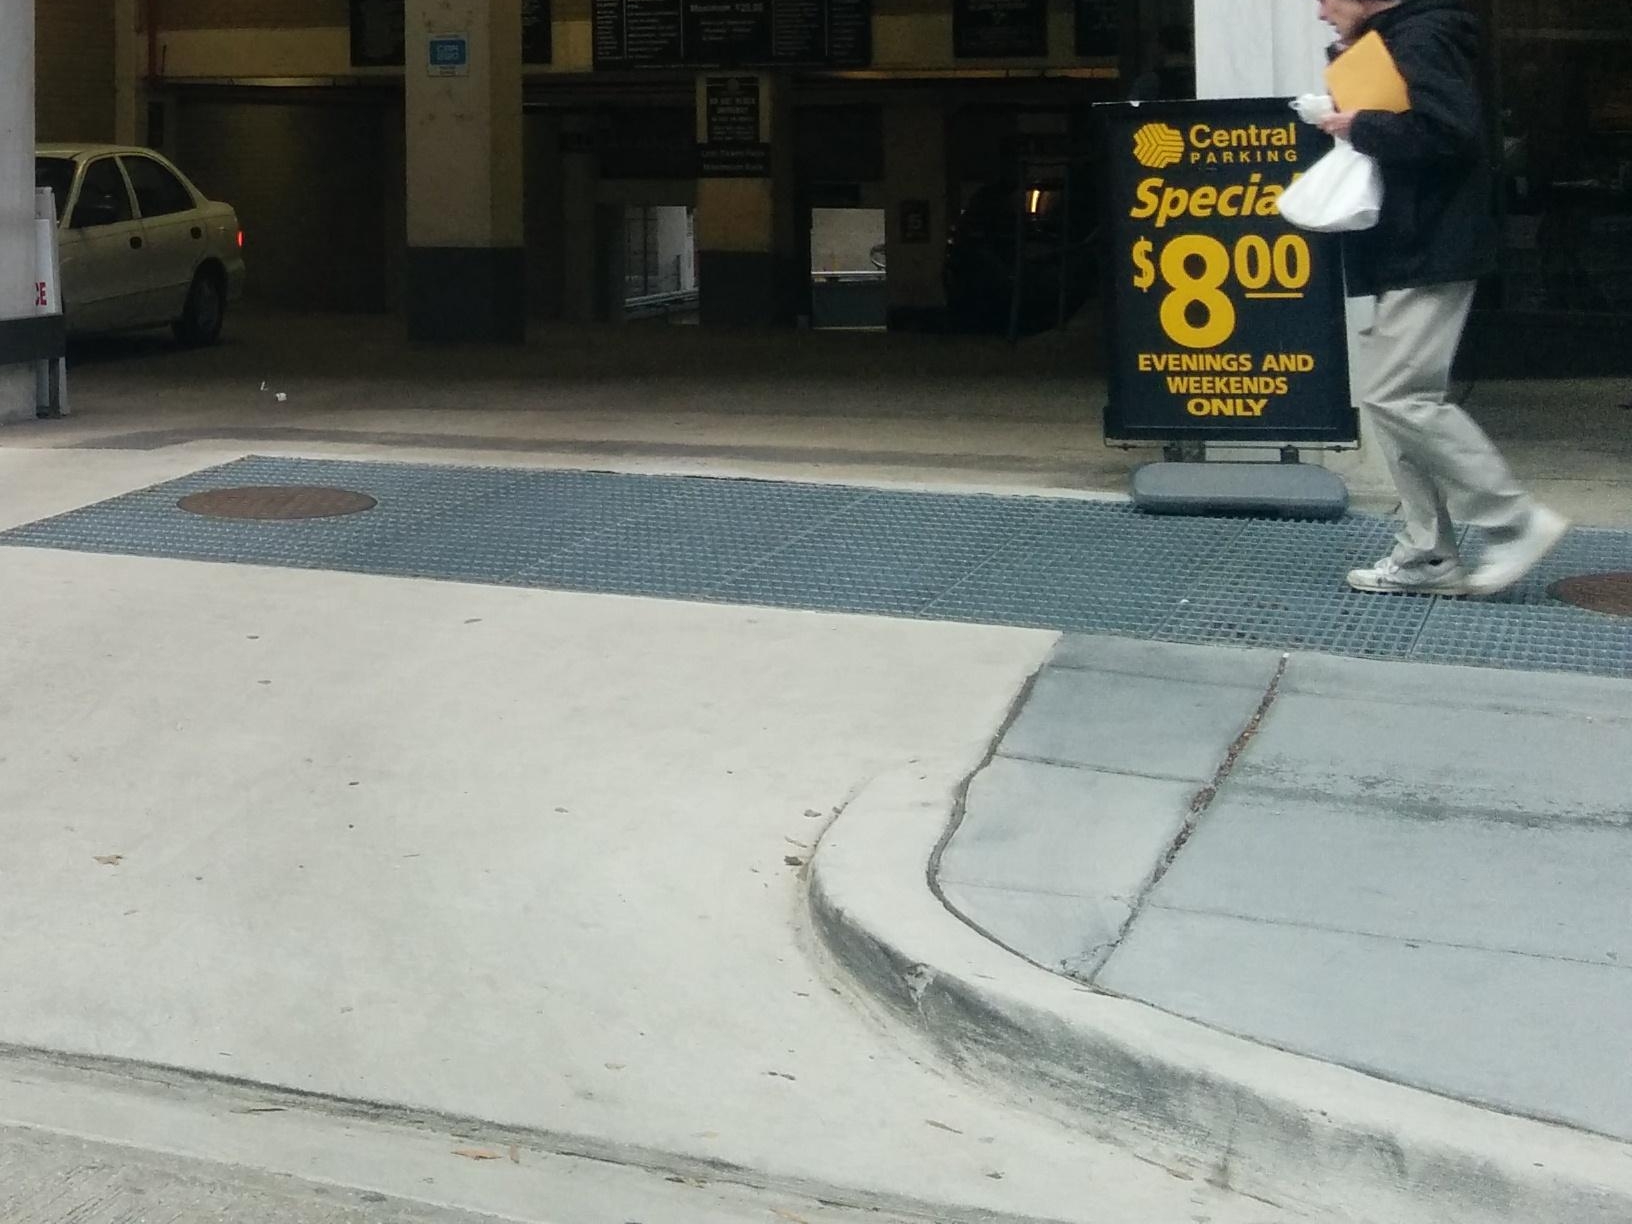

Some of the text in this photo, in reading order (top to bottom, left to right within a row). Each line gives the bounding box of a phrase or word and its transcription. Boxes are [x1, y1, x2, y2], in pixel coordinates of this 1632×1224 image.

[1189, 122, 1297, 148] Central
[1190, 150, 1297, 164] PARKING
[1130, 172, 1304, 228] Specia
[1138, 353, 1314, 372] EVENINGS AND
[1166, 376, 1288, 394] WEEKENDS
[1187, 397, 1268, 417] ONLY
